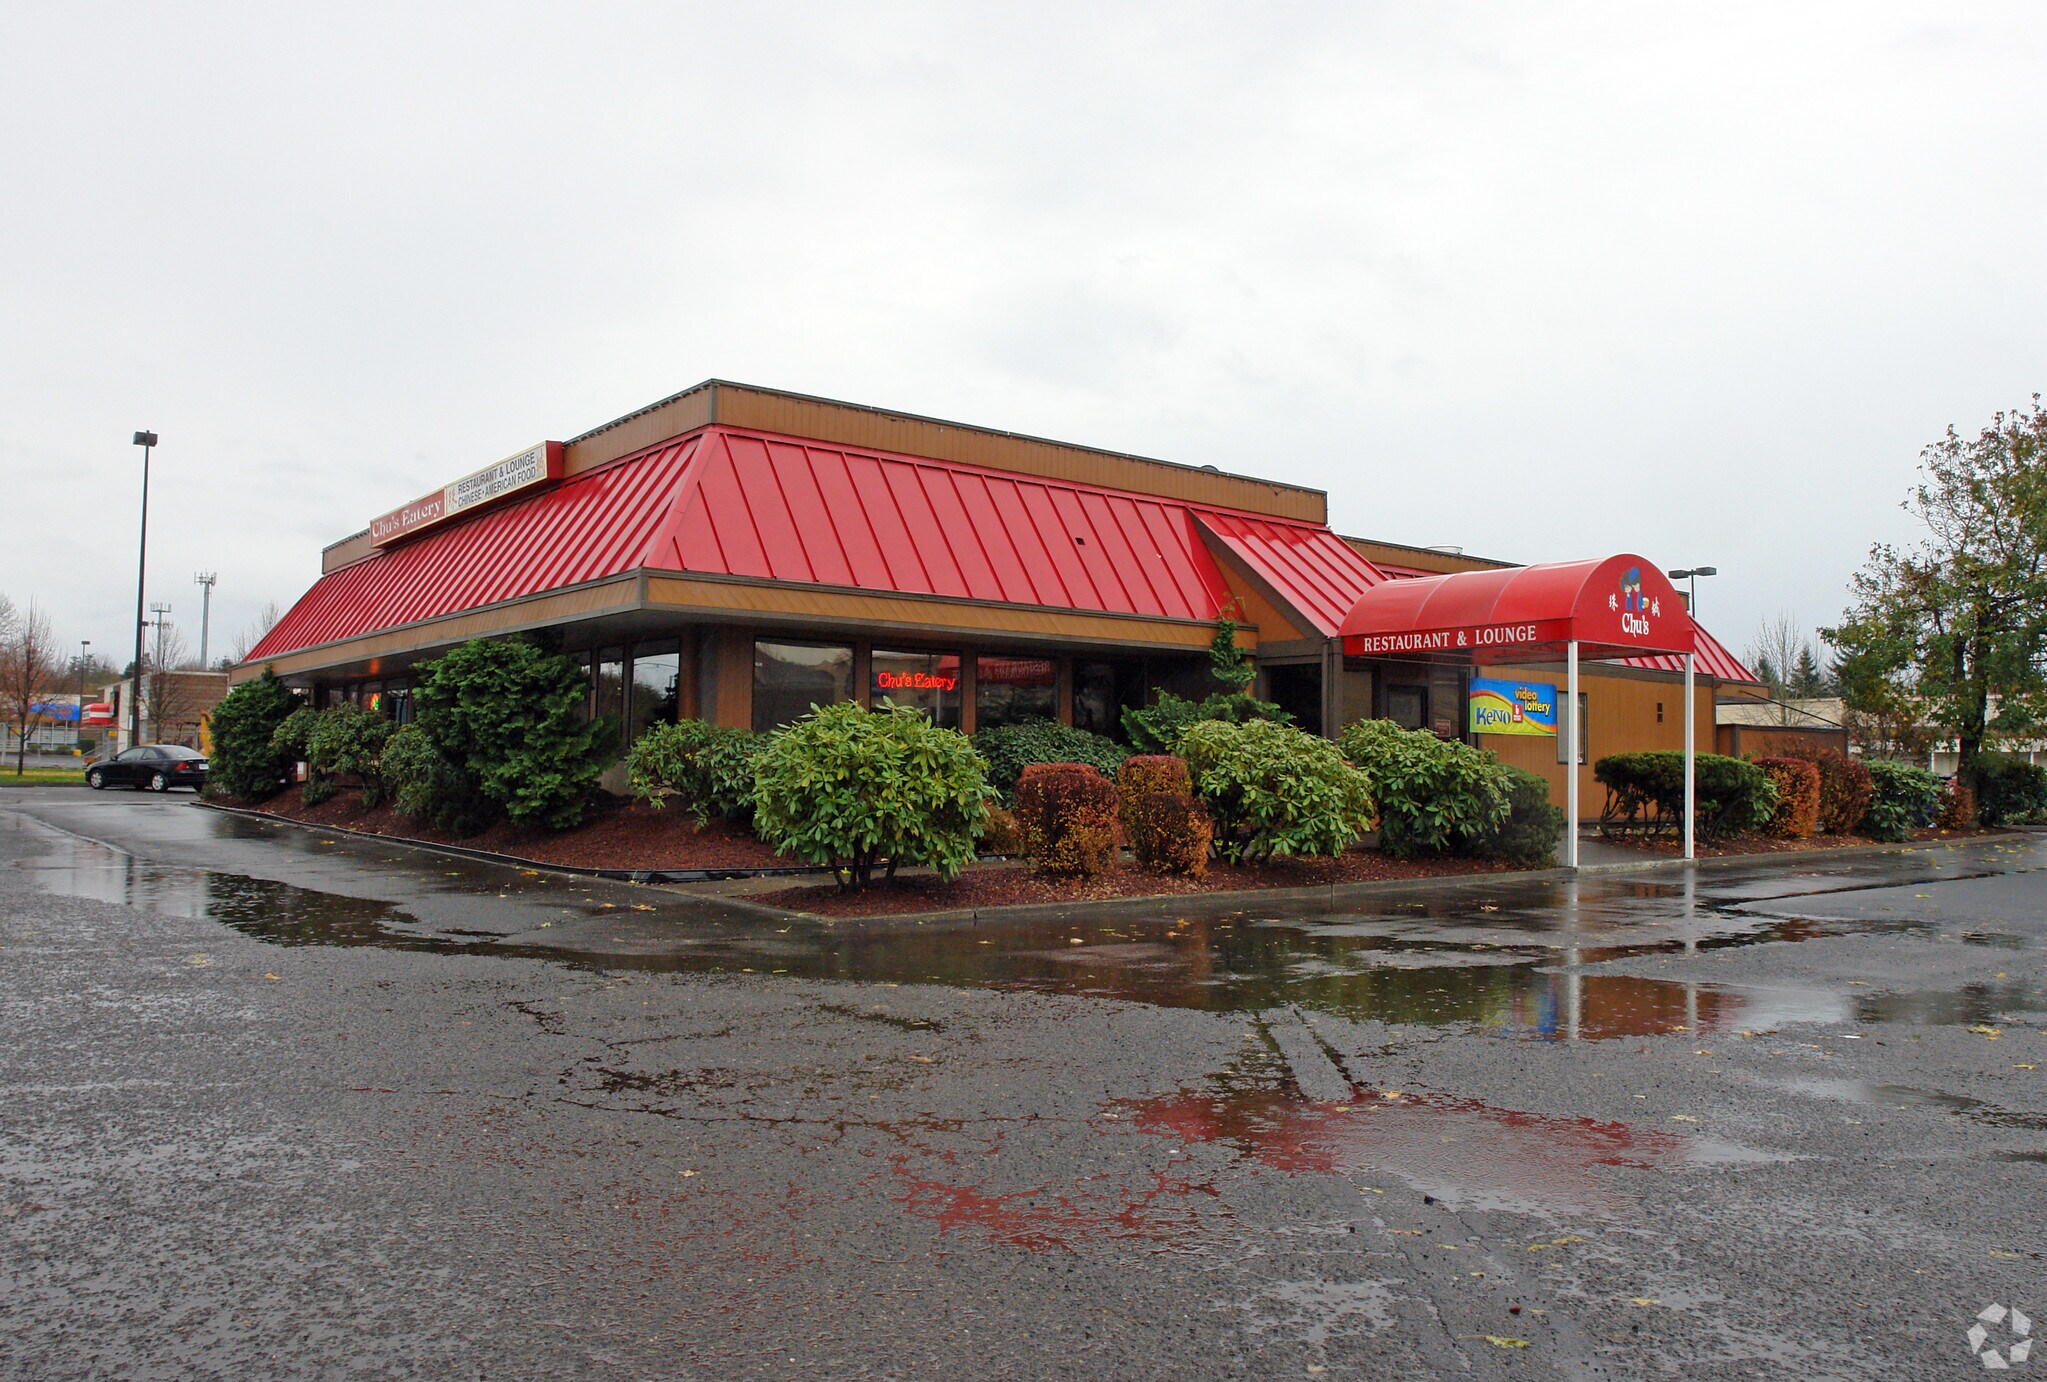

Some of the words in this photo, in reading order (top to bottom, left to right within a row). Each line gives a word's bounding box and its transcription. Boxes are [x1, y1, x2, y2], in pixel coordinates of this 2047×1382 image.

[458, 469, 498, 495] RESTAURANT
[499, 467, 505, 478] &
[506, 452, 535, 475] LOUNGE
[517, 467, 536, 484] FOOD
[372, 516, 400, 537] Chu's
[402, 501, 441, 527] Eatery
[1622, 612, 1650, 638] Chu's
[1364, 632, 1450, 652] RESTAURANT
[1457, 630, 1467, 646] &
[1475, 625, 1537, 645] LOUNGE
[878, 671, 912, 688] Chu's
[914, 672, 956, 691] Eatery
[1514, 686, 1538, 701] video
[1524, 700, 1551, 717] lottery
